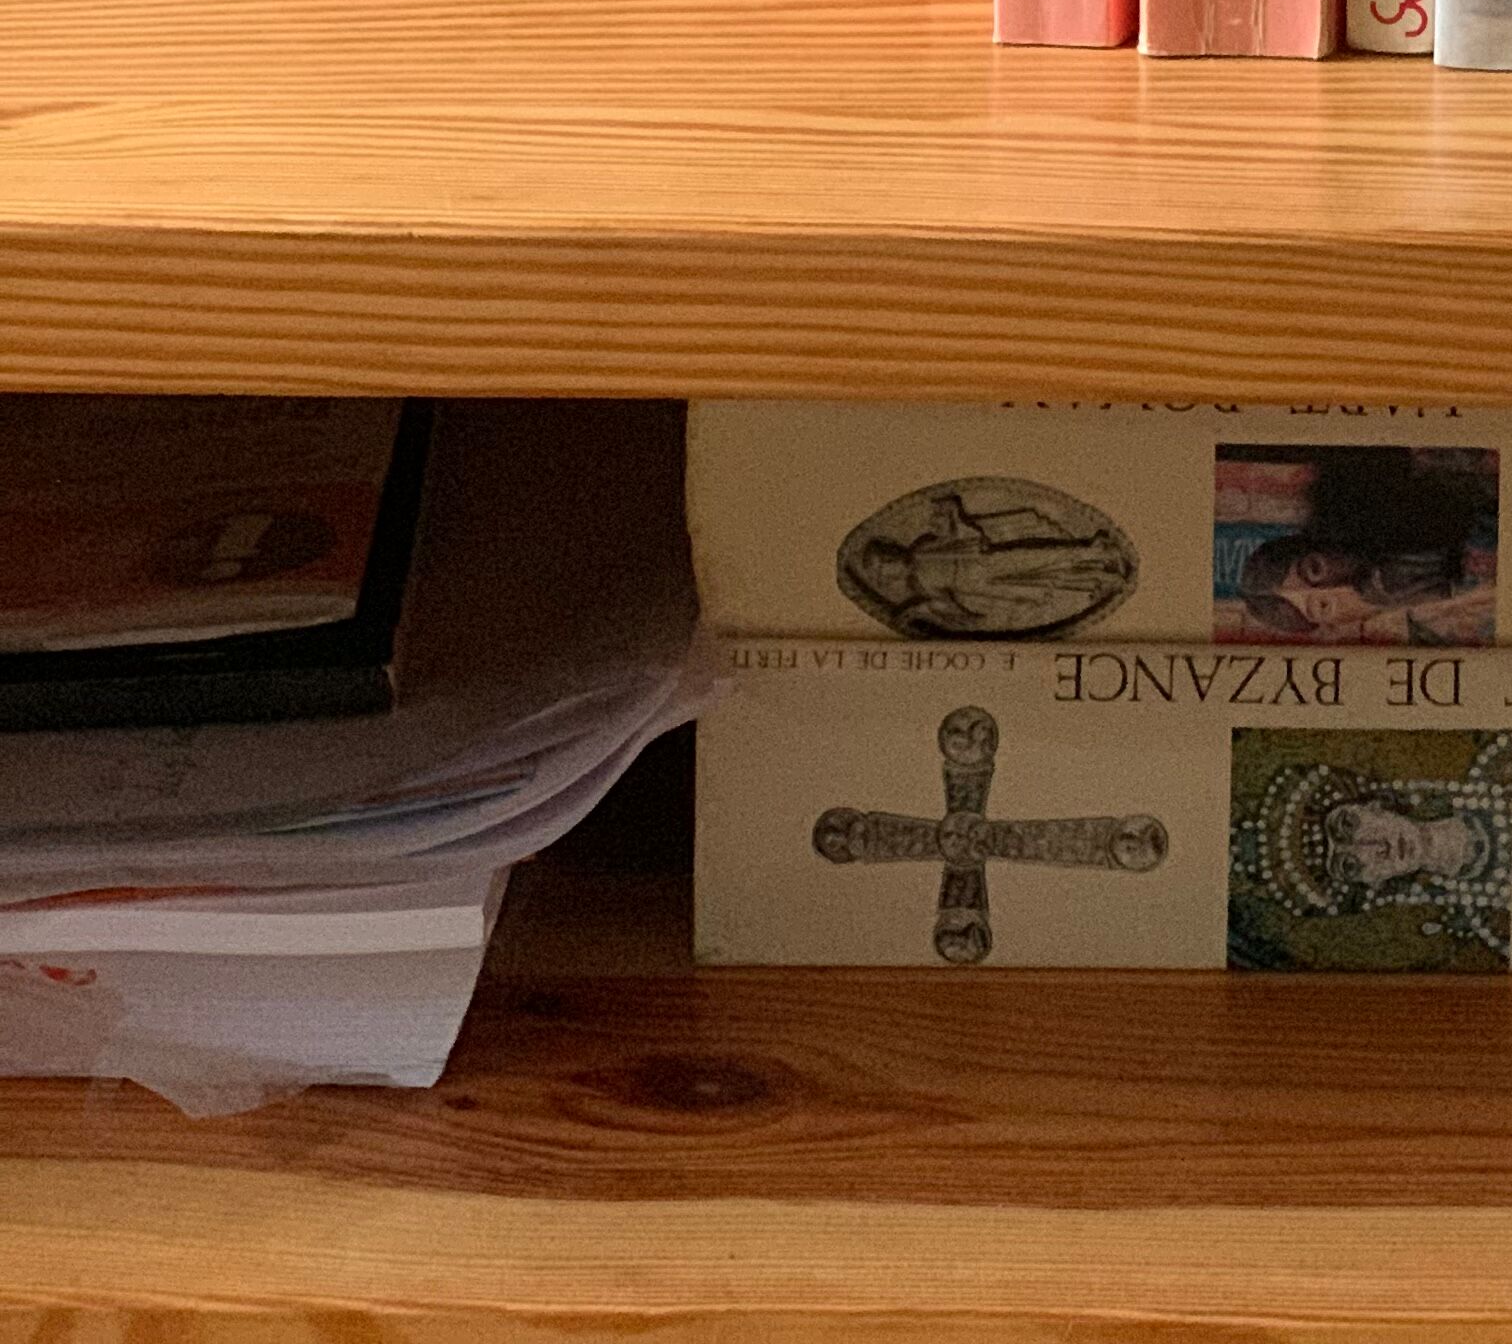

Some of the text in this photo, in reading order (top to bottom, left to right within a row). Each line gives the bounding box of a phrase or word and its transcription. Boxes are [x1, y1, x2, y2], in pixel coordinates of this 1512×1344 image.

[814, 650, 844, 671] LA
[859, 650, 889, 671] DE
[901, 650, 985, 671] COCHE
[1053, 652, 1345, 707] BYZANCE
[1386, 658, 1465, 707] DE
